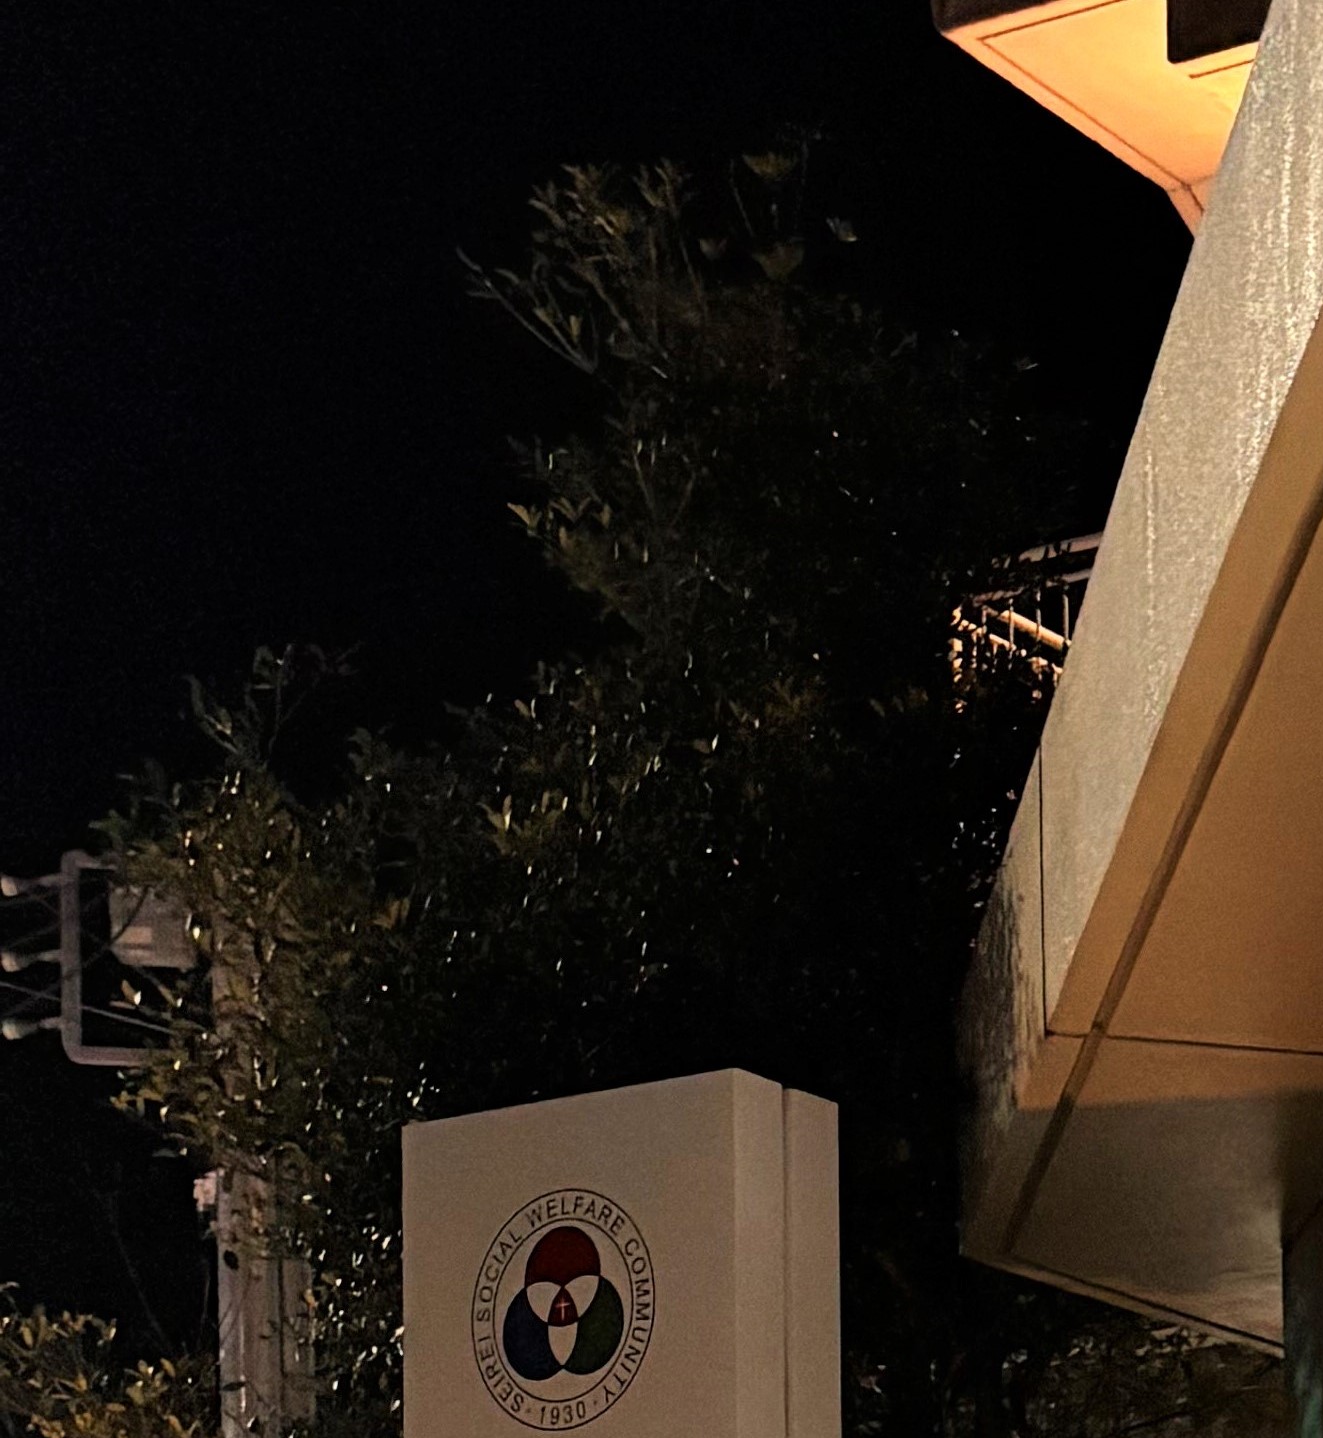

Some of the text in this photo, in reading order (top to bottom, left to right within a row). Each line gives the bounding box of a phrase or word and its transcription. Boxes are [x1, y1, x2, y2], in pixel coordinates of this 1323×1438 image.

[476, 1196, 651, 1413] SEIREI SOCIAL WELFARE COMMUNITY
[540, 1401, 587, 1425] 1930
